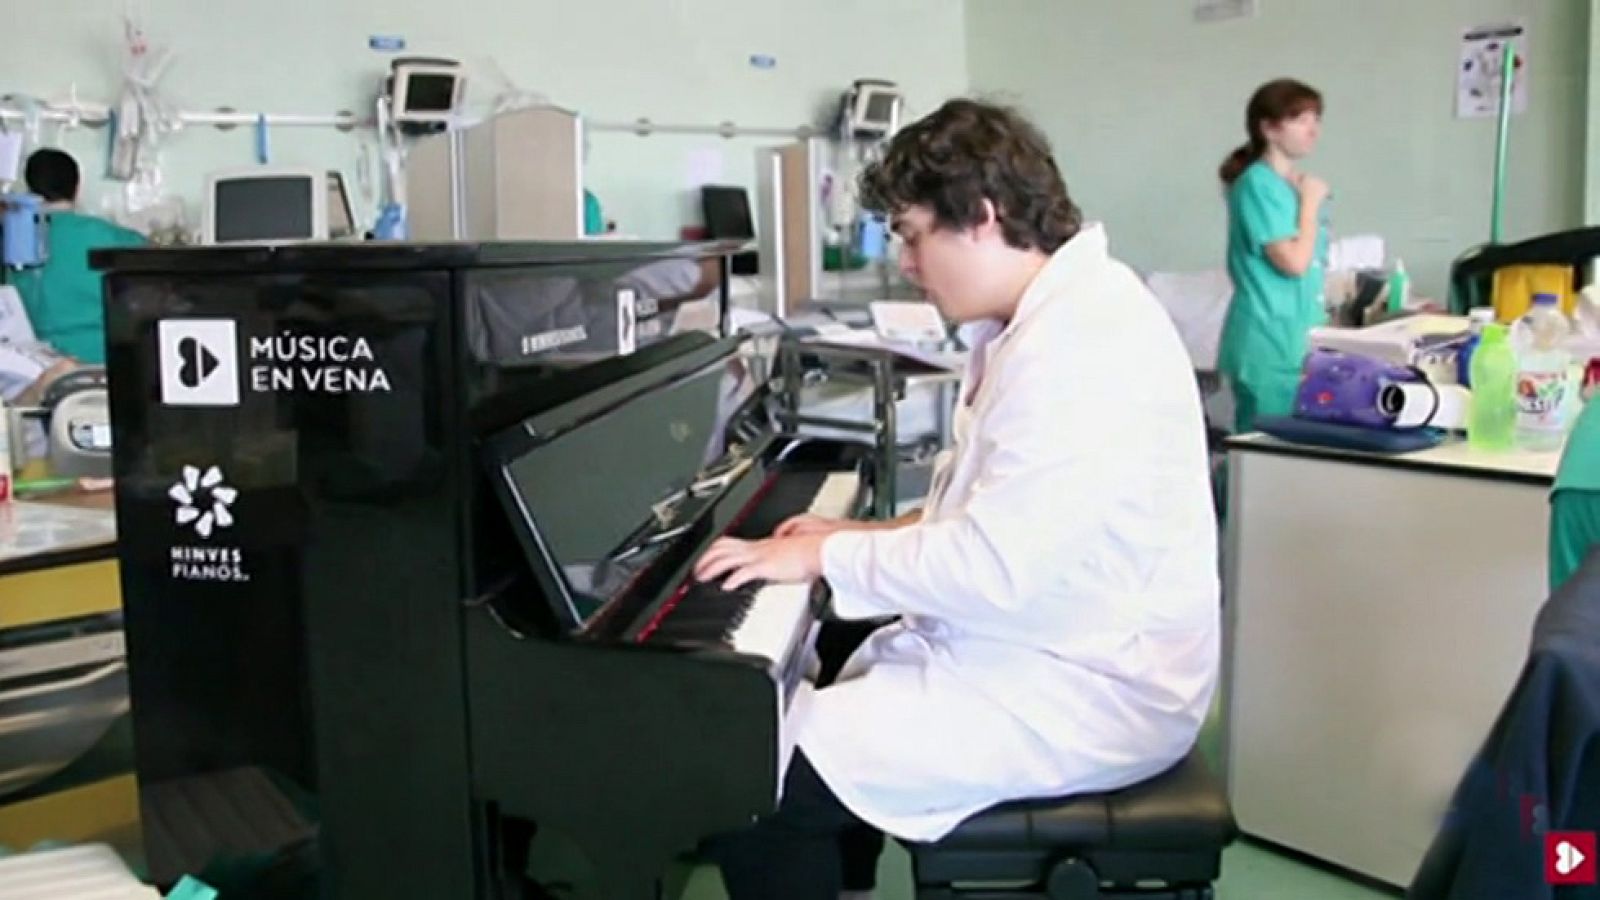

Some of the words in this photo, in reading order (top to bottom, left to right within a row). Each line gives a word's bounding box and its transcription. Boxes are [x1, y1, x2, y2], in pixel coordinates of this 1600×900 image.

[251, 330, 374, 362] MÚSICA
[252, 366, 294, 392] EN
[302, 367, 391, 392] VENA
